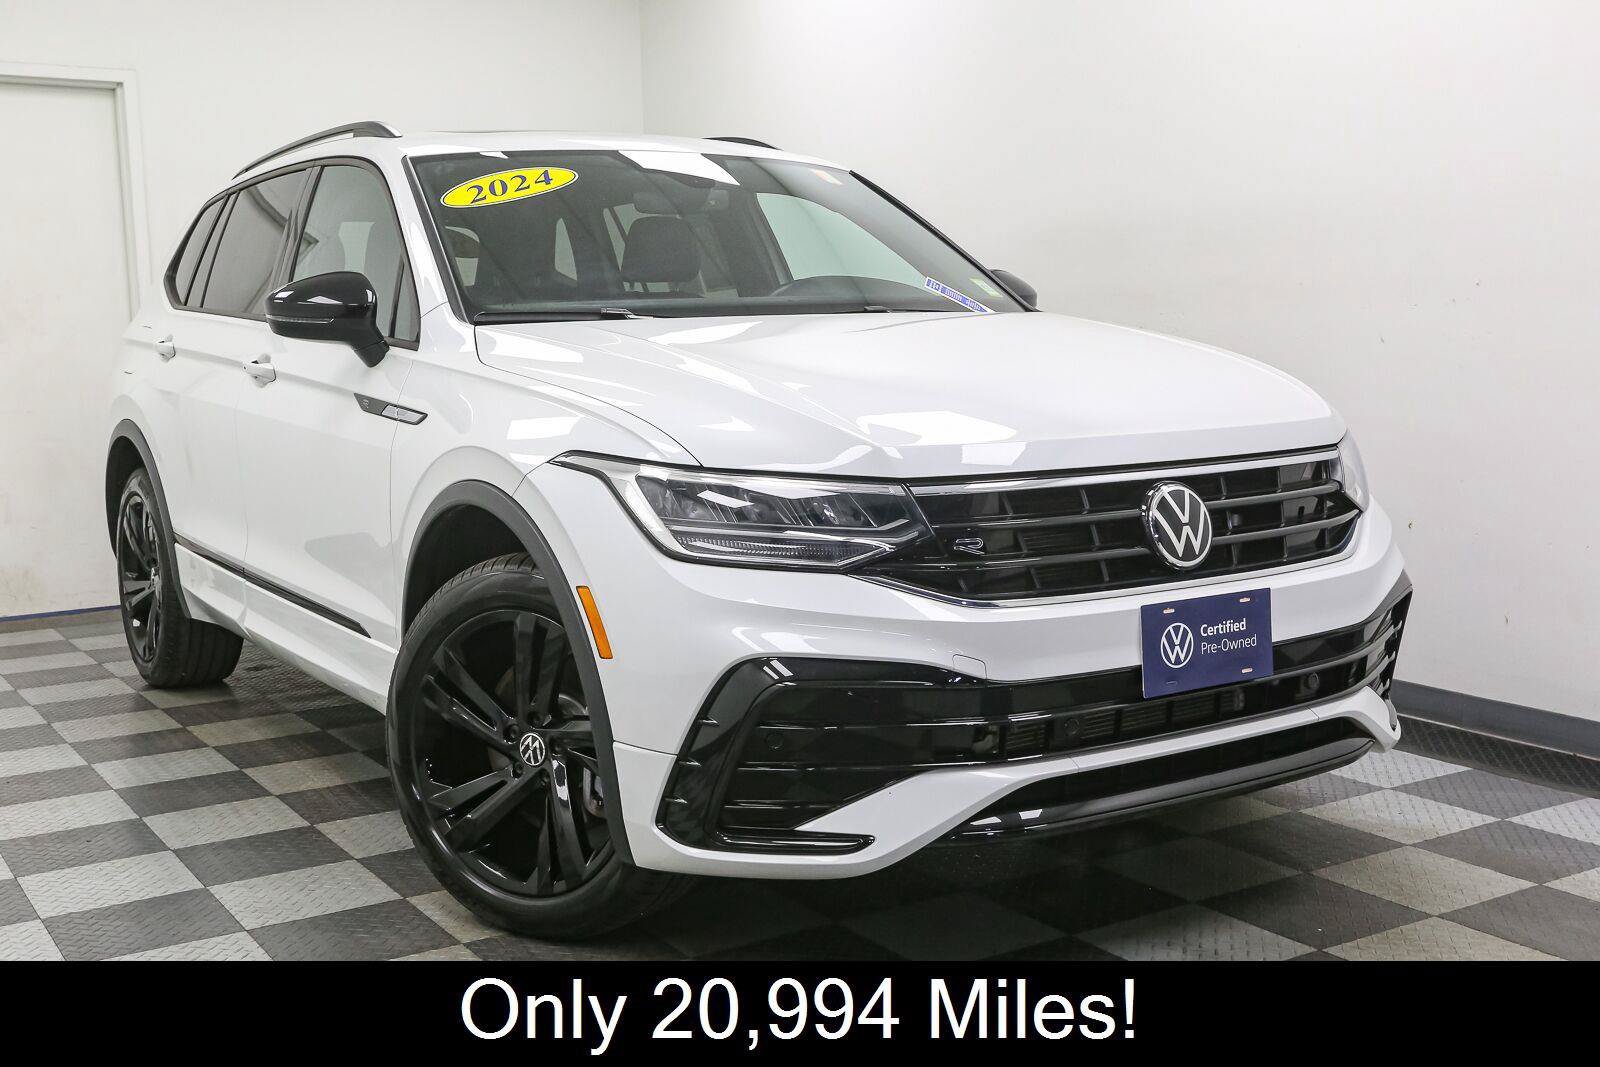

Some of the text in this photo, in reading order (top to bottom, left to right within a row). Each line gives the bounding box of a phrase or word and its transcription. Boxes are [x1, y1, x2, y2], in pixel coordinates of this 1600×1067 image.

[467, 169, 553, 204] 2024
[1200, 617, 1247, 637] Certified
[1201, 634, 1257, 655] Pre-Owned
